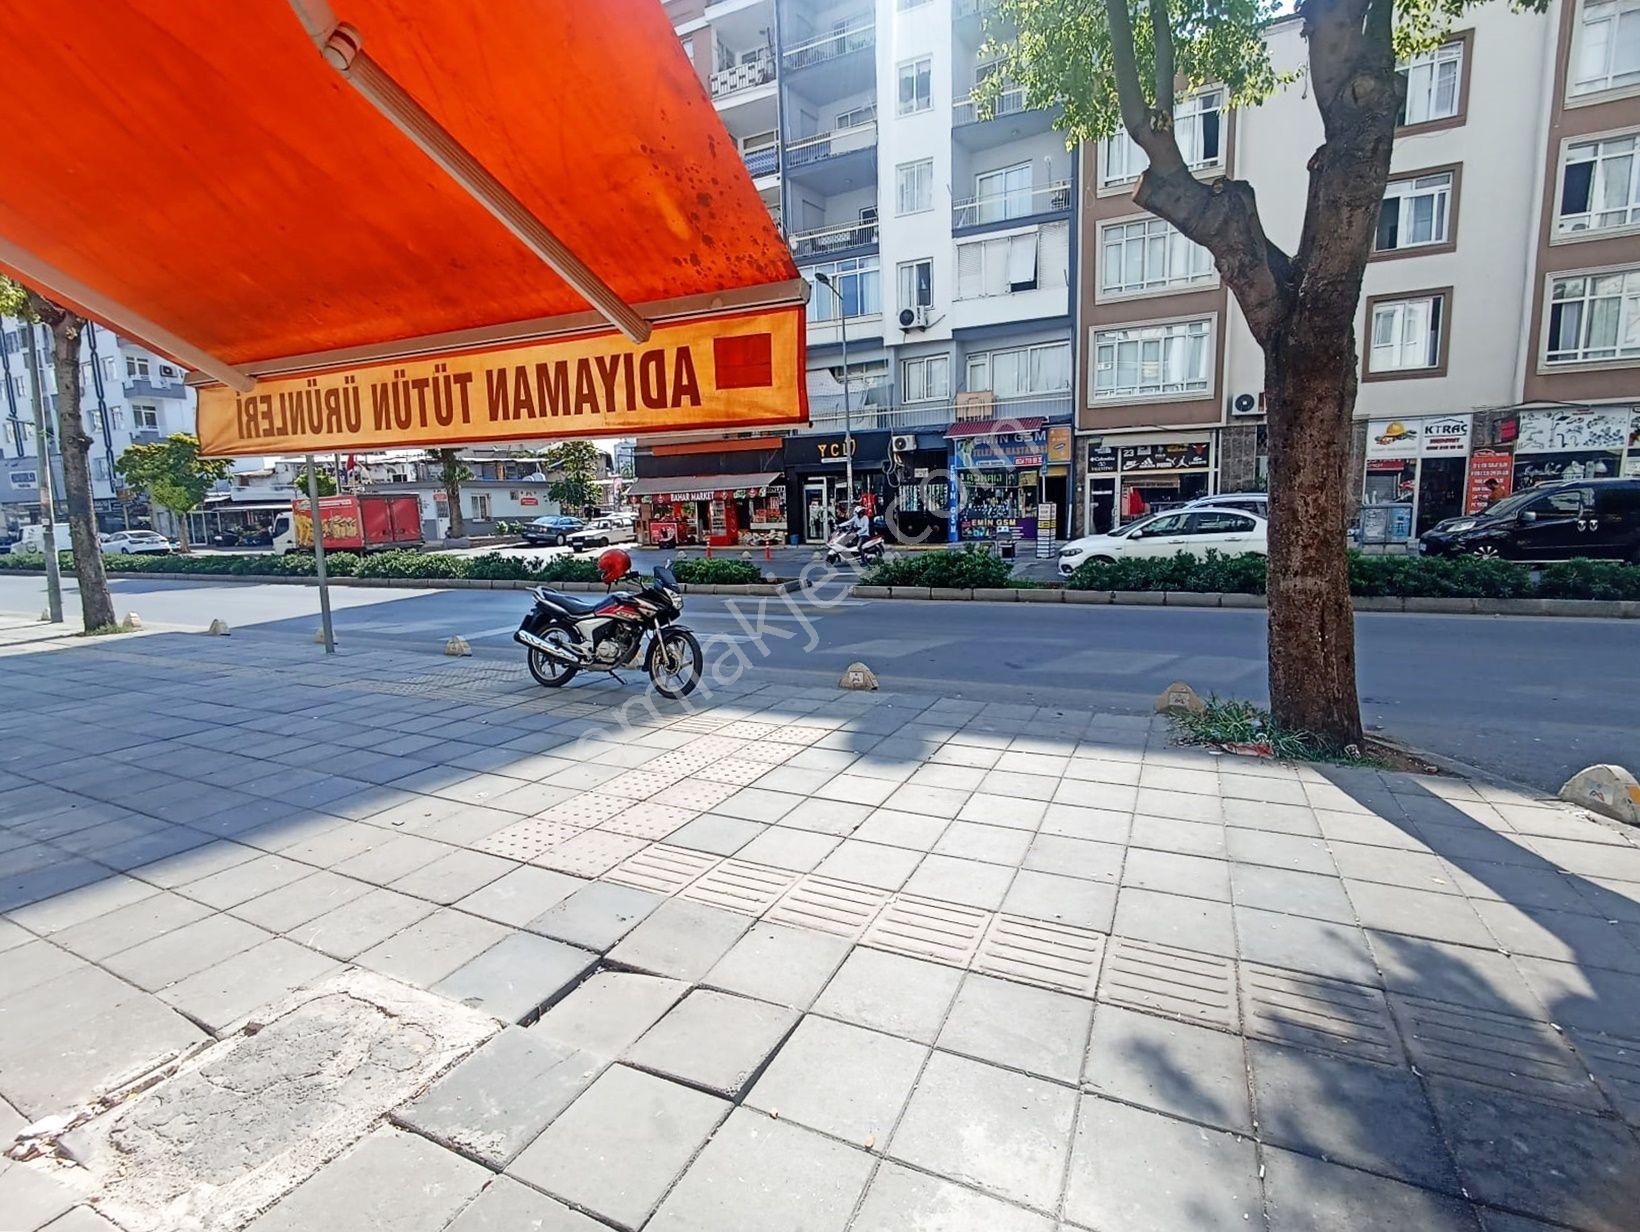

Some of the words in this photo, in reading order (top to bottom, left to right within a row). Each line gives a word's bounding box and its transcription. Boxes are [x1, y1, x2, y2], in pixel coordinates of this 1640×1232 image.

[1014, 431, 1046, 443] GSM
[1123, 449, 1135, 458] 23
[670, 492, 690, 502] BAHAR
[690, 491, 715, 501] MARKET
